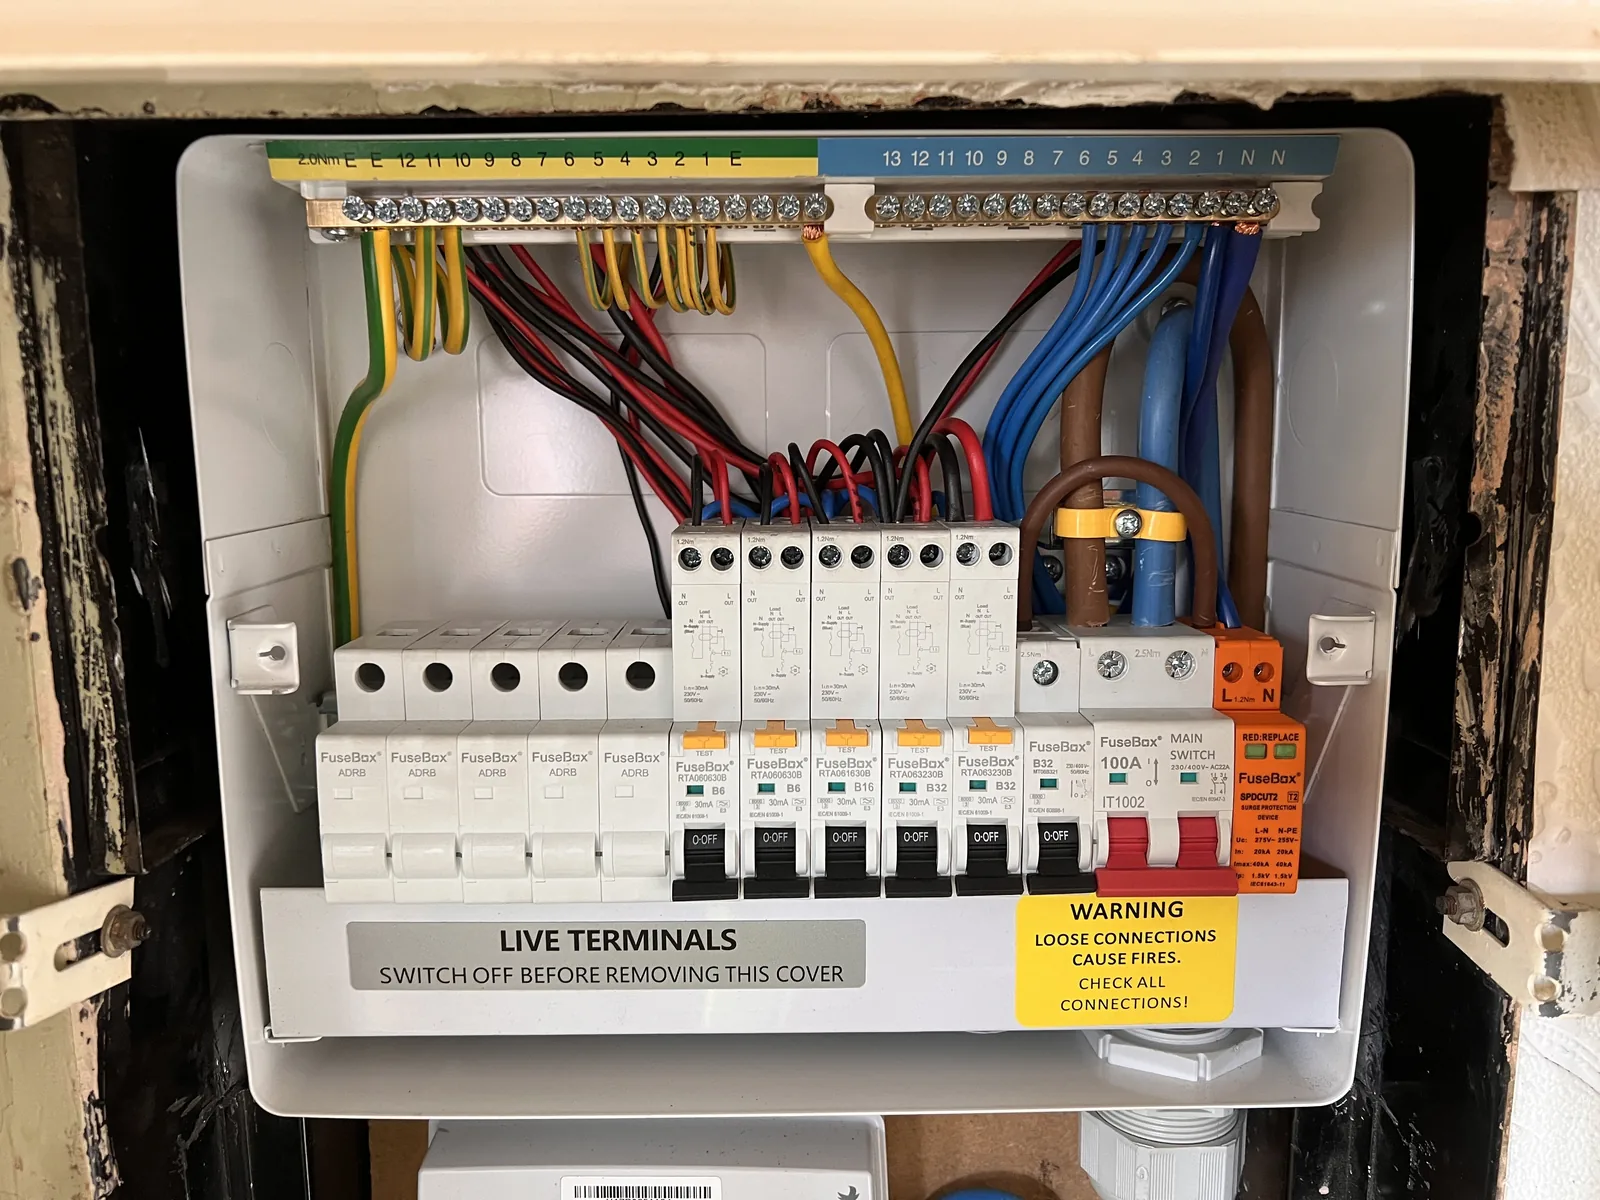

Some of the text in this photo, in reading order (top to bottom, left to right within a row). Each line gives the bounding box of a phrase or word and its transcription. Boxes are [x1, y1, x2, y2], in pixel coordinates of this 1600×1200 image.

[298, 150, 742, 168] 2.0Nm E E 12 11 10 9 8 7 6 5 4 3 2 1 E
[882, 150, 1285, 167] 13 12 11 10 9 8 7 6 5 4 3 2 1 N N
[1135, 649, 1161, 658] 2.5Nm
[1222, 688, 1232, 702] L
[1263, 688, 1274, 702] N
[1170, 733, 1203, 743] MAIN
[1170, 750, 1216, 760] SWITCH
[1033, 759, 1053, 768] B32
[1101, 756, 1142, 770] 100A
[338, 768, 366, 778] ADRB
[408, 768, 436, 778] ADRB
[478, 768, 506, 778] ADRB
[549, 767, 577, 777] ADRB
[621, 768, 649, 777] ADRB
[890, 770, 944, 778] RTA063230B
[961, 769, 1012, 777] RTA063230B
[678, 774, 727, 782] RTA060630B
[712, 786, 725, 795] B6
[787, 784, 801, 793] B6
[854, 782, 874, 792] B16
[926, 784, 948, 792] B32
[996, 782, 1016, 791] B32
[909, 798, 930, 806] 30mA
[1102, 796, 1145, 808] IT1002
[1240, 793, 1278, 801] SPDCUT2
[694, 800, 714, 808] 30mA
[1070, 900, 1184, 921] WARNING
[500, 928, 737, 952] LIVE TERMINALS
[1035, 929, 1217, 947] LOOSE CONNECTIONS
[1072, 951, 1181, 966] CAUSE FIRES.
[380, 965, 844, 984] SWITCH OFF BEFORE REMOVING THIS COVER
[1079, 976, 1166, 990] CHECK ALL
[1060, 996, 1188, 1011] CONNECTIONS!
